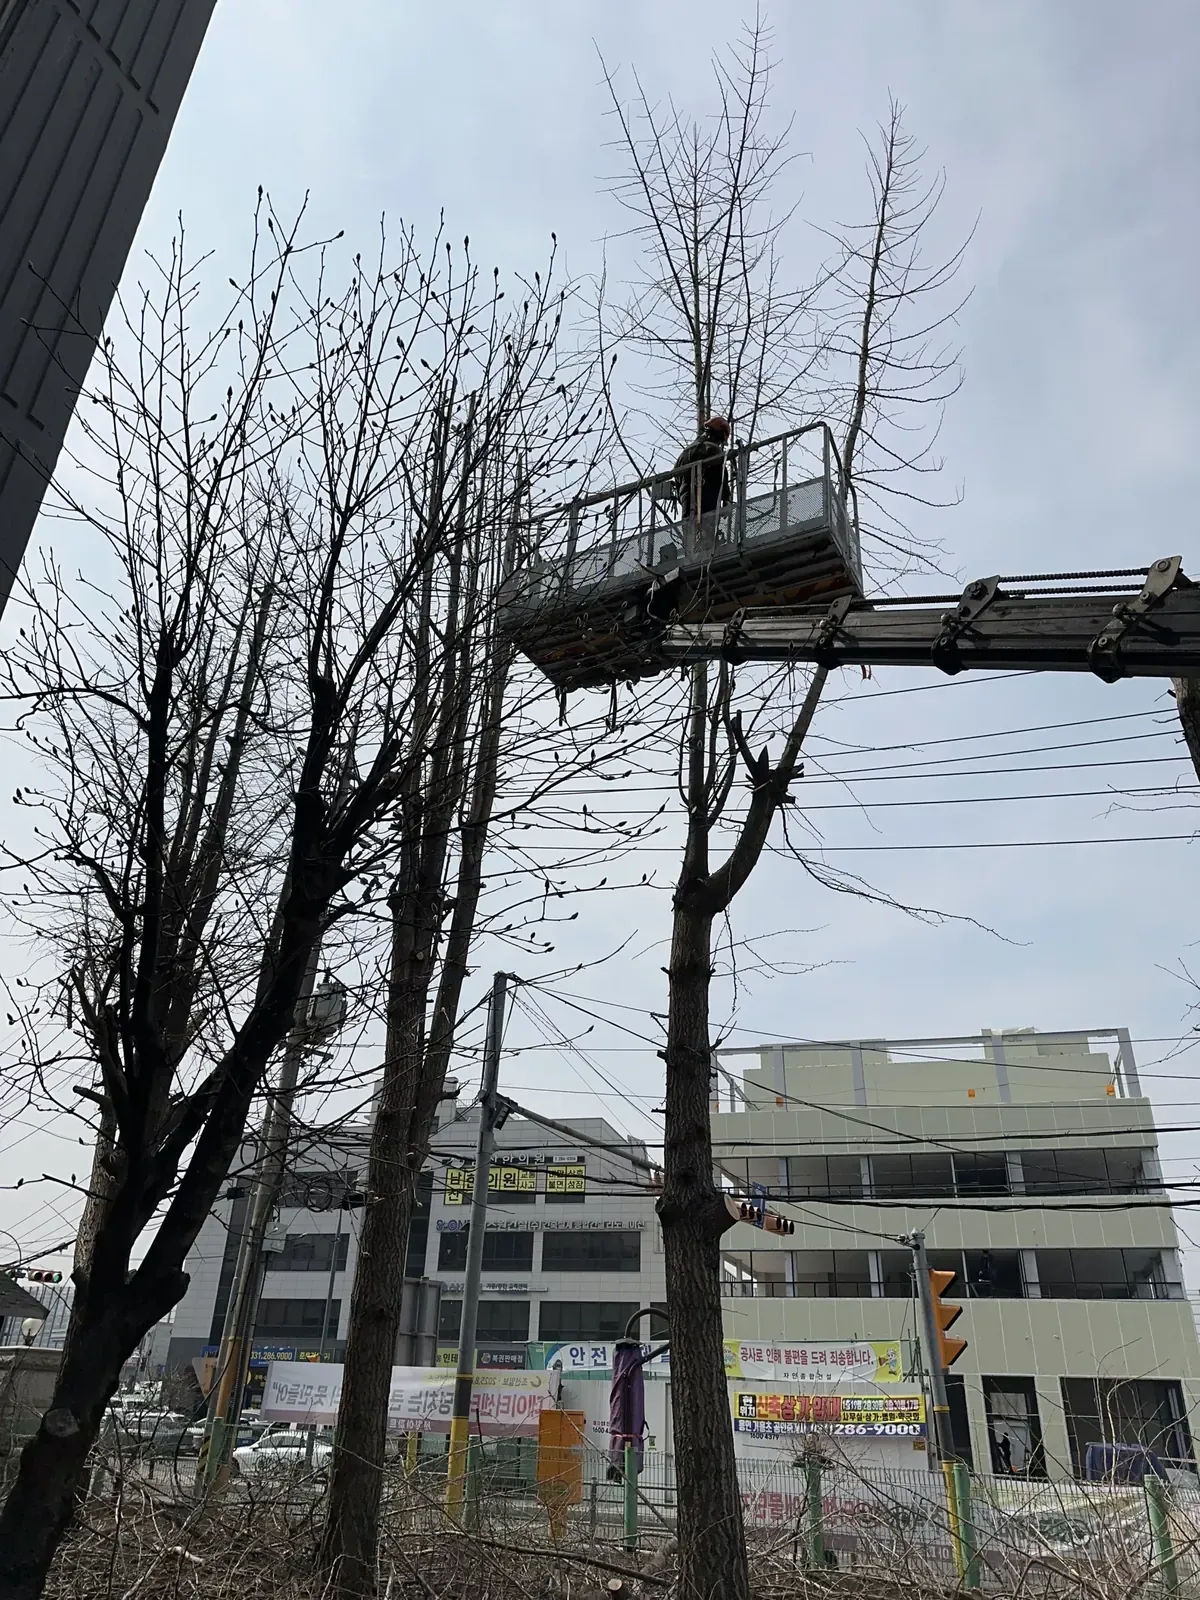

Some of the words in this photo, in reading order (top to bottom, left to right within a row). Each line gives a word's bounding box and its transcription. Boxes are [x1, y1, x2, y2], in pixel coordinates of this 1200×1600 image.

[519, 1180, 536, 1190] 사고
[567, 1180, 584, 1189] 성장
[492, 1354, 523, 1363] 복권판매점
[569, 1346, 607, 1366] 안전
[740, 1347, 763, 1363] 공사로
[766, 1348, 782, 1364] 인해
[784, 1349, 809, 1365] 불편을
[811, 1350, 828, 1366] 드려
[830, 1349, 874, 1366] 죄송합니다.
